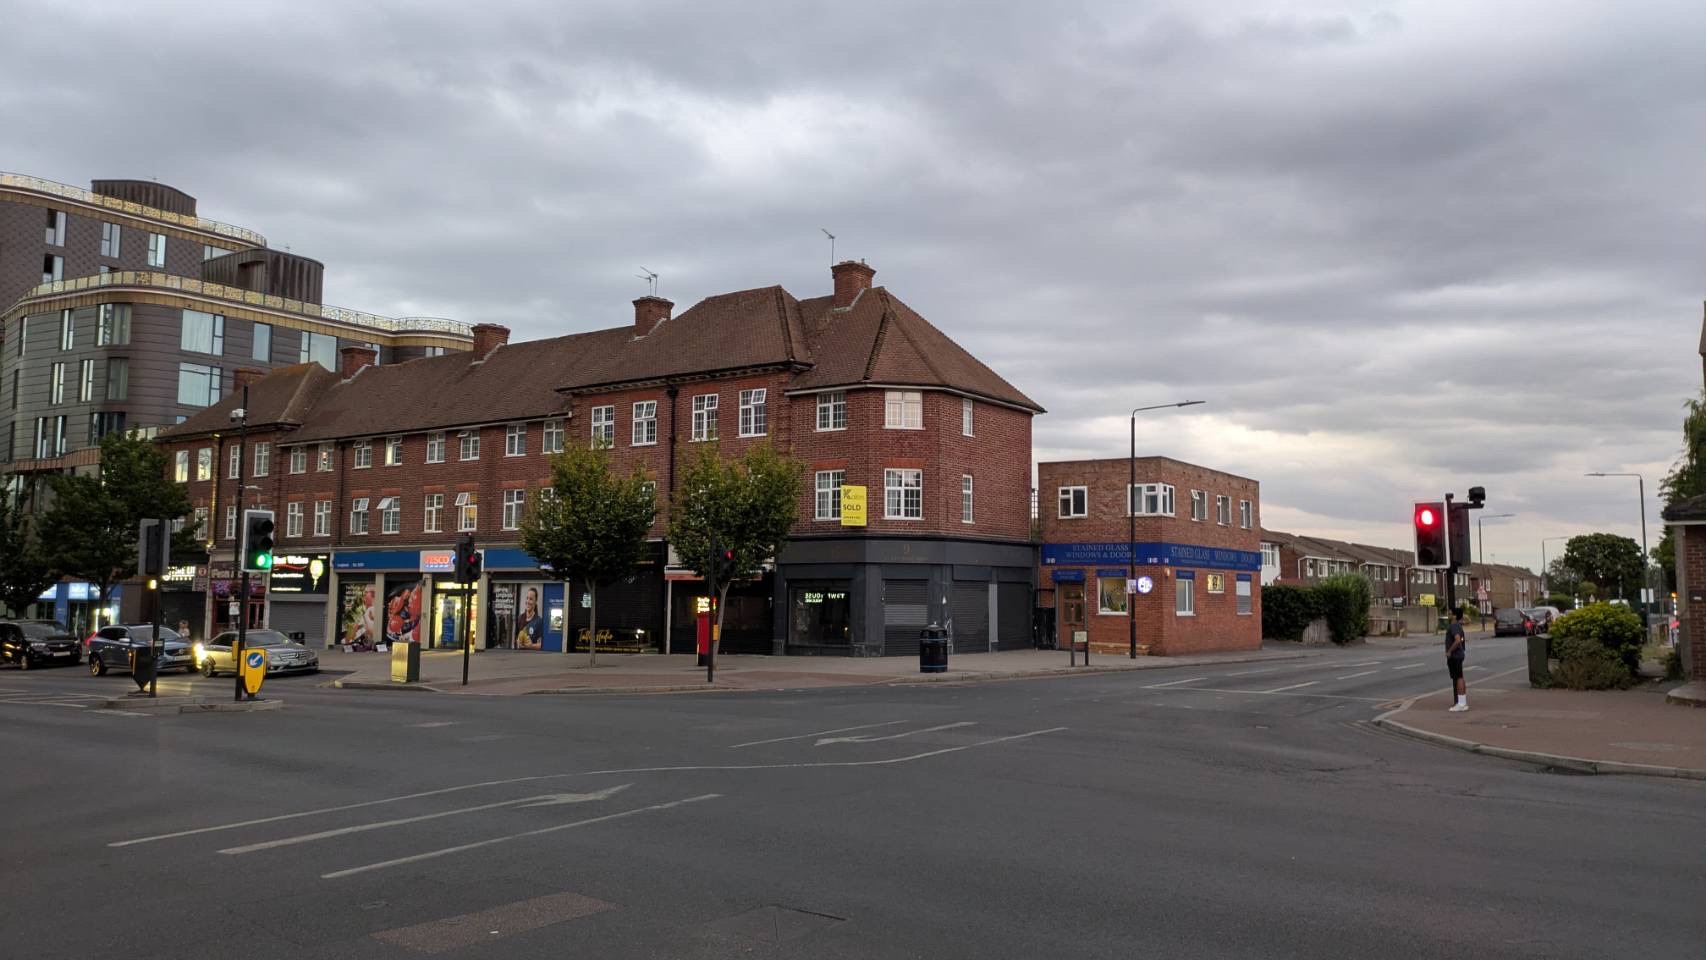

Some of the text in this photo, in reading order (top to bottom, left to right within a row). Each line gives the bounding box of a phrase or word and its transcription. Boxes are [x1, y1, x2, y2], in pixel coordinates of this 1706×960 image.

[1072, 544, 1128, 552] STAINED GLASS
[1064, 551, 1100, 559] WINDOWS
[1195, 549, 1209, 560] GLASS
[425, 555, 449, 564] TESCO
